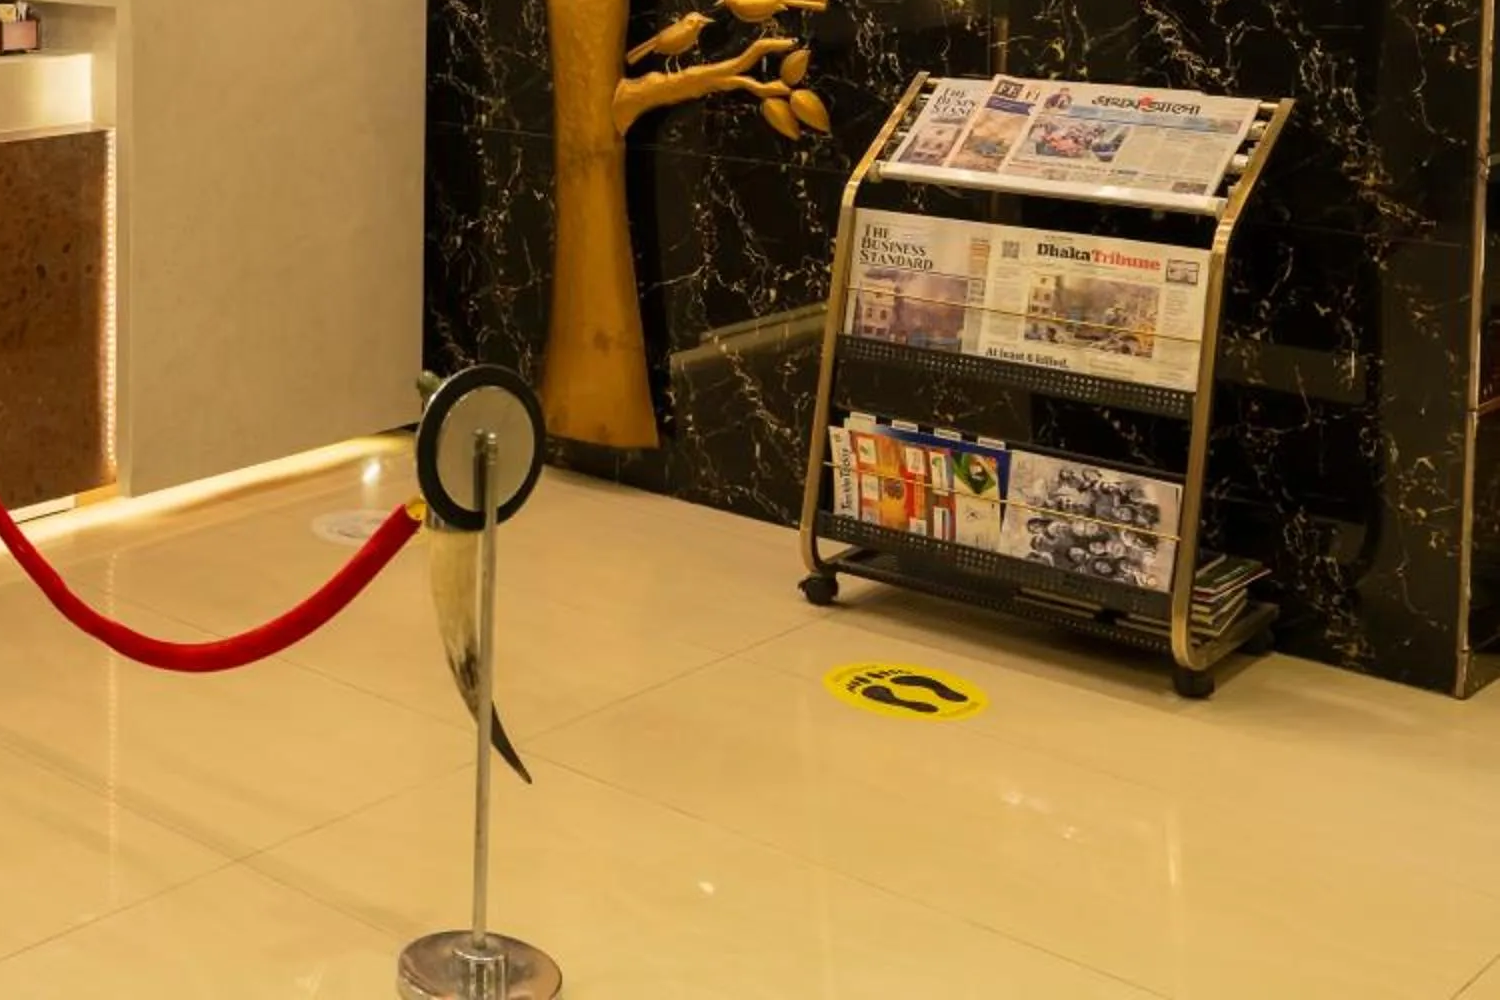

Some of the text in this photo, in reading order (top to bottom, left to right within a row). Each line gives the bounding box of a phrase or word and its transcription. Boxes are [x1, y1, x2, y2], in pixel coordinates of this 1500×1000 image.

[865, 224, 889, 239] THE
[861, 238, 927, 257] BUSINESS
[860, 249, 934, 270] STANDARD
